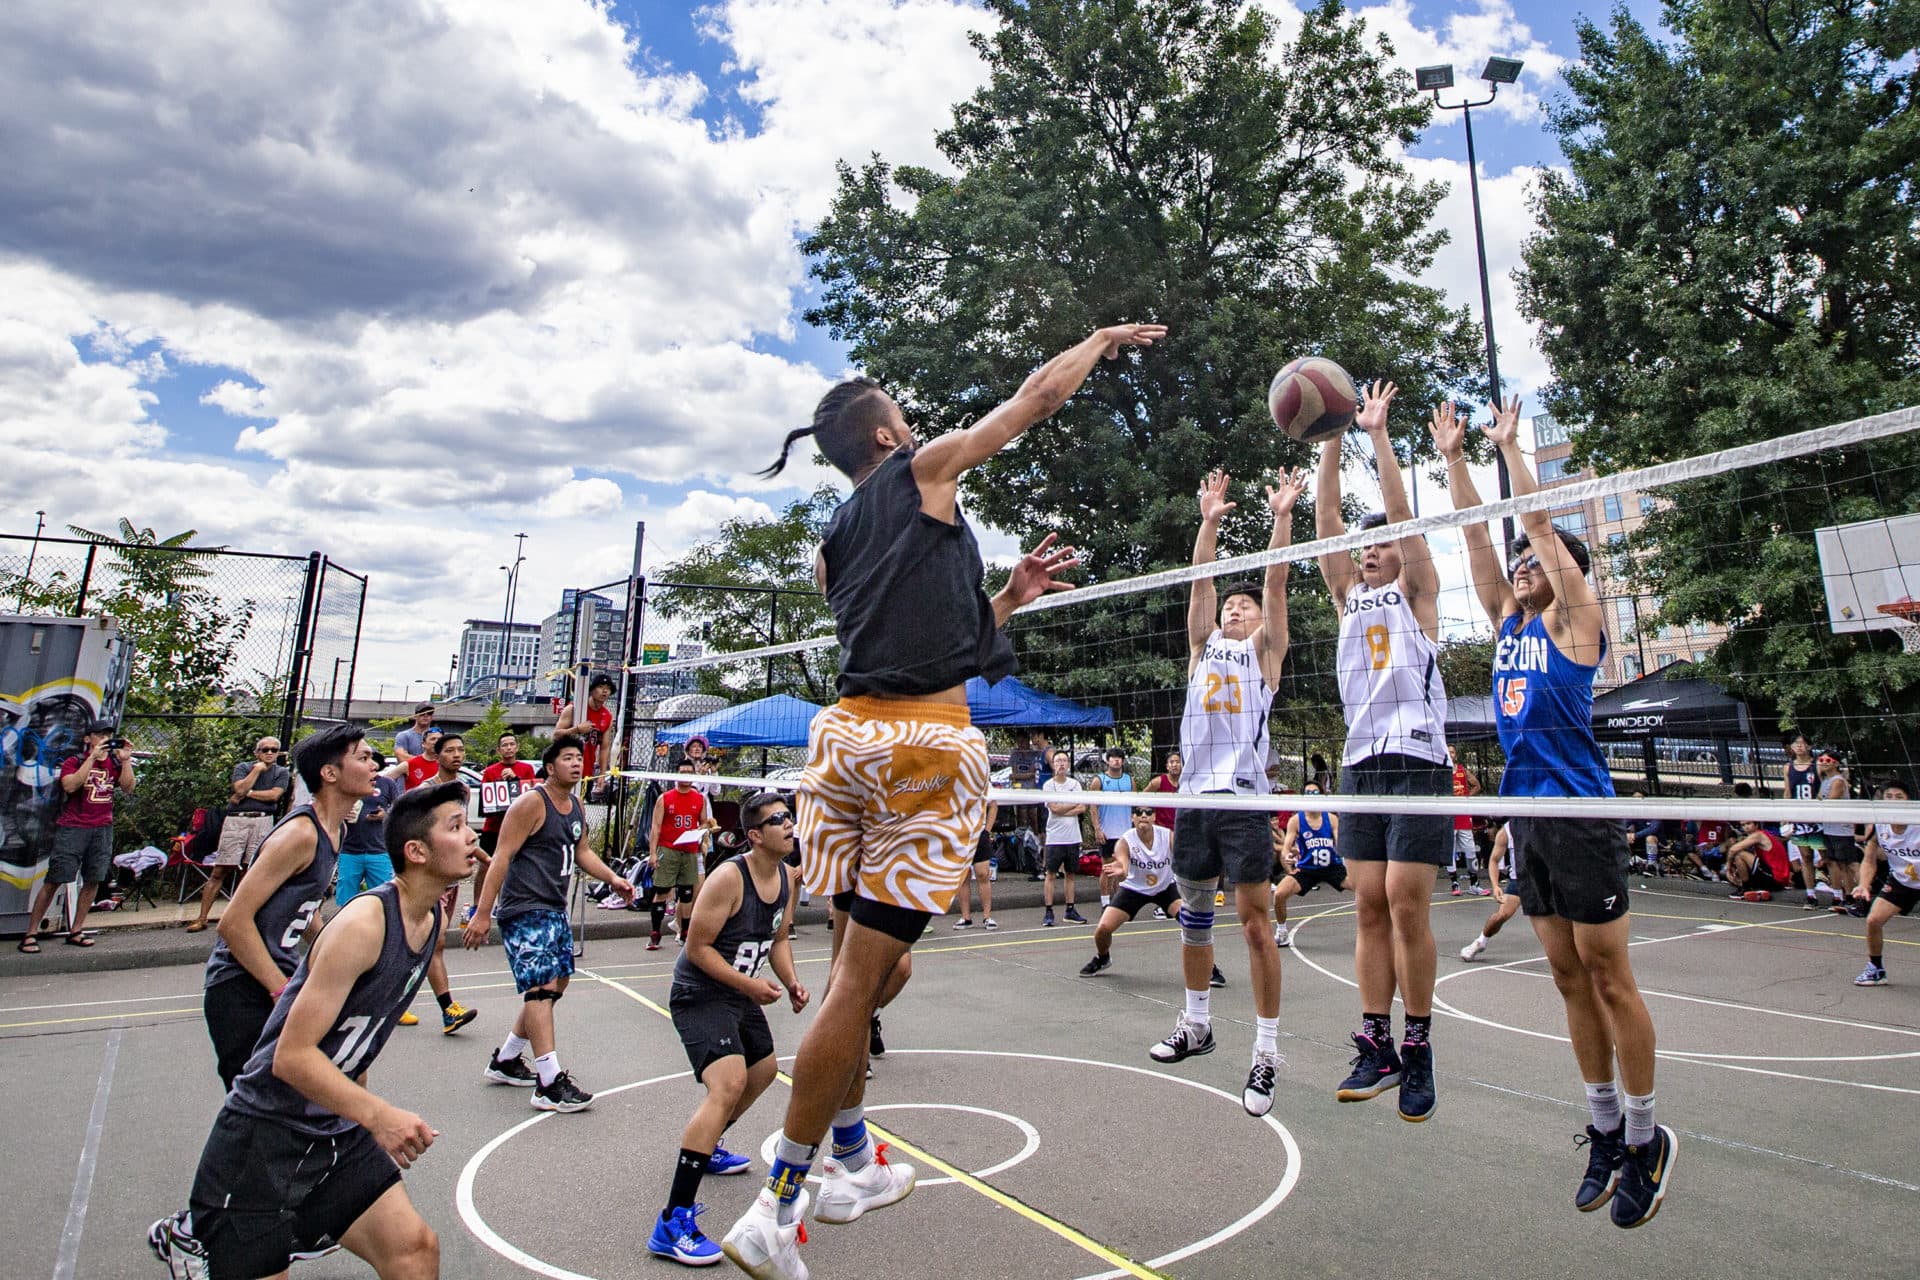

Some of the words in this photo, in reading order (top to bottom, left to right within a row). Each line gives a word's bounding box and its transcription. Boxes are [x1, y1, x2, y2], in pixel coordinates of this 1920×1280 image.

[1535, 416, 1557, 432] NO
[1365, 624, 1390, 671] 8
[1203, 673, 1242, 713] 23
[1497, 677, 1527, 717] 15
[510, 783, 518, 793] 2
[1795, 784, 1812, 800] 18
[674, 814, 693, 829] 35
[560, 843, 575, 877] 11
[1311, 848, 1331, 866] 19
[1904, 863, 1918, 880] 4
[280, 900, 322, 948] 2
